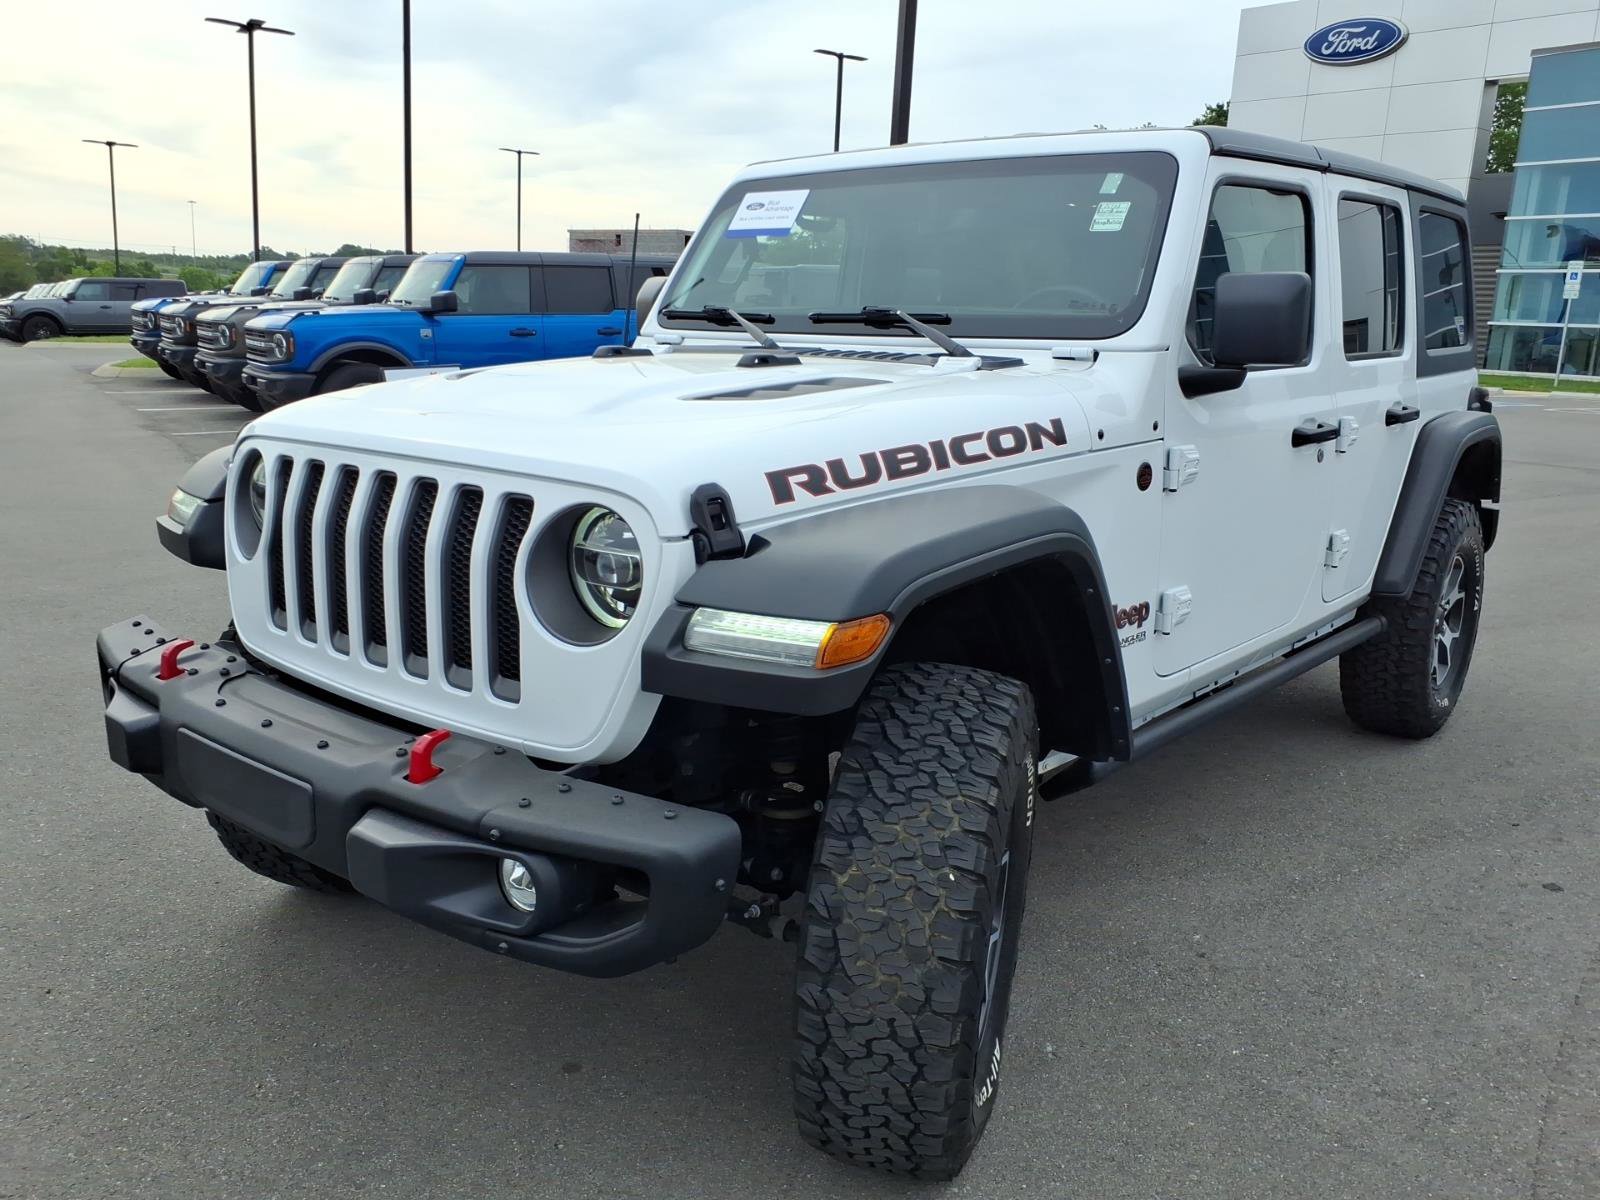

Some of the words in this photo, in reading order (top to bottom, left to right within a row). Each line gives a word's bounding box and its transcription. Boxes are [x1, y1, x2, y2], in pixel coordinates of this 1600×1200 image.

[1321, 26, 1381, 55] Ford
[764, 418, 1068, 505] RUBICON
[1119, 631, 1146, 645] NGLER
